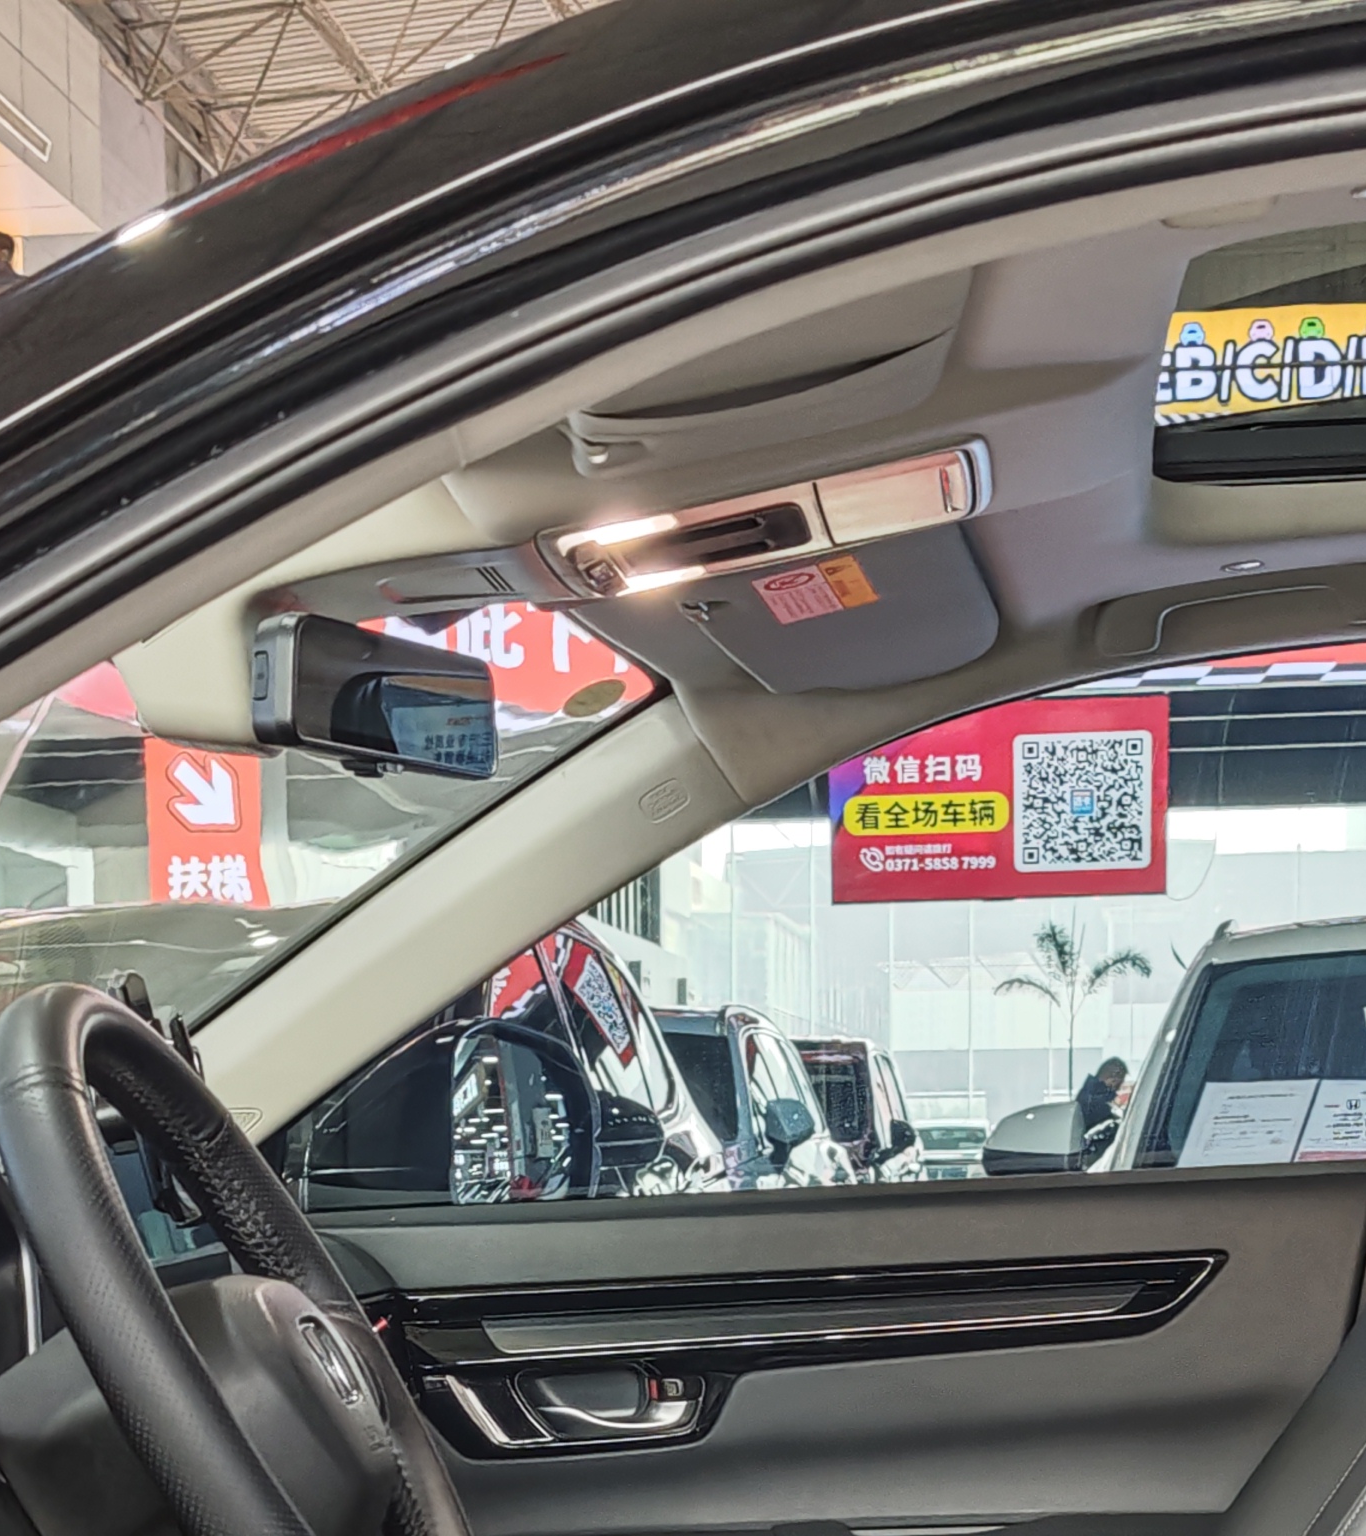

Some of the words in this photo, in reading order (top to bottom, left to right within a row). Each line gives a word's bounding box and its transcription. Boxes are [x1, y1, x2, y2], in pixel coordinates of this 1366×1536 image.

[862, 755, 983, 784] 微信扫码
[855, 799, 996, 830] 看全场车辆
[167, 854, 253, 903] 扶梯
[885, 856, 960, 872] 0371-5858
[960, 855, 997, 870] 7999
